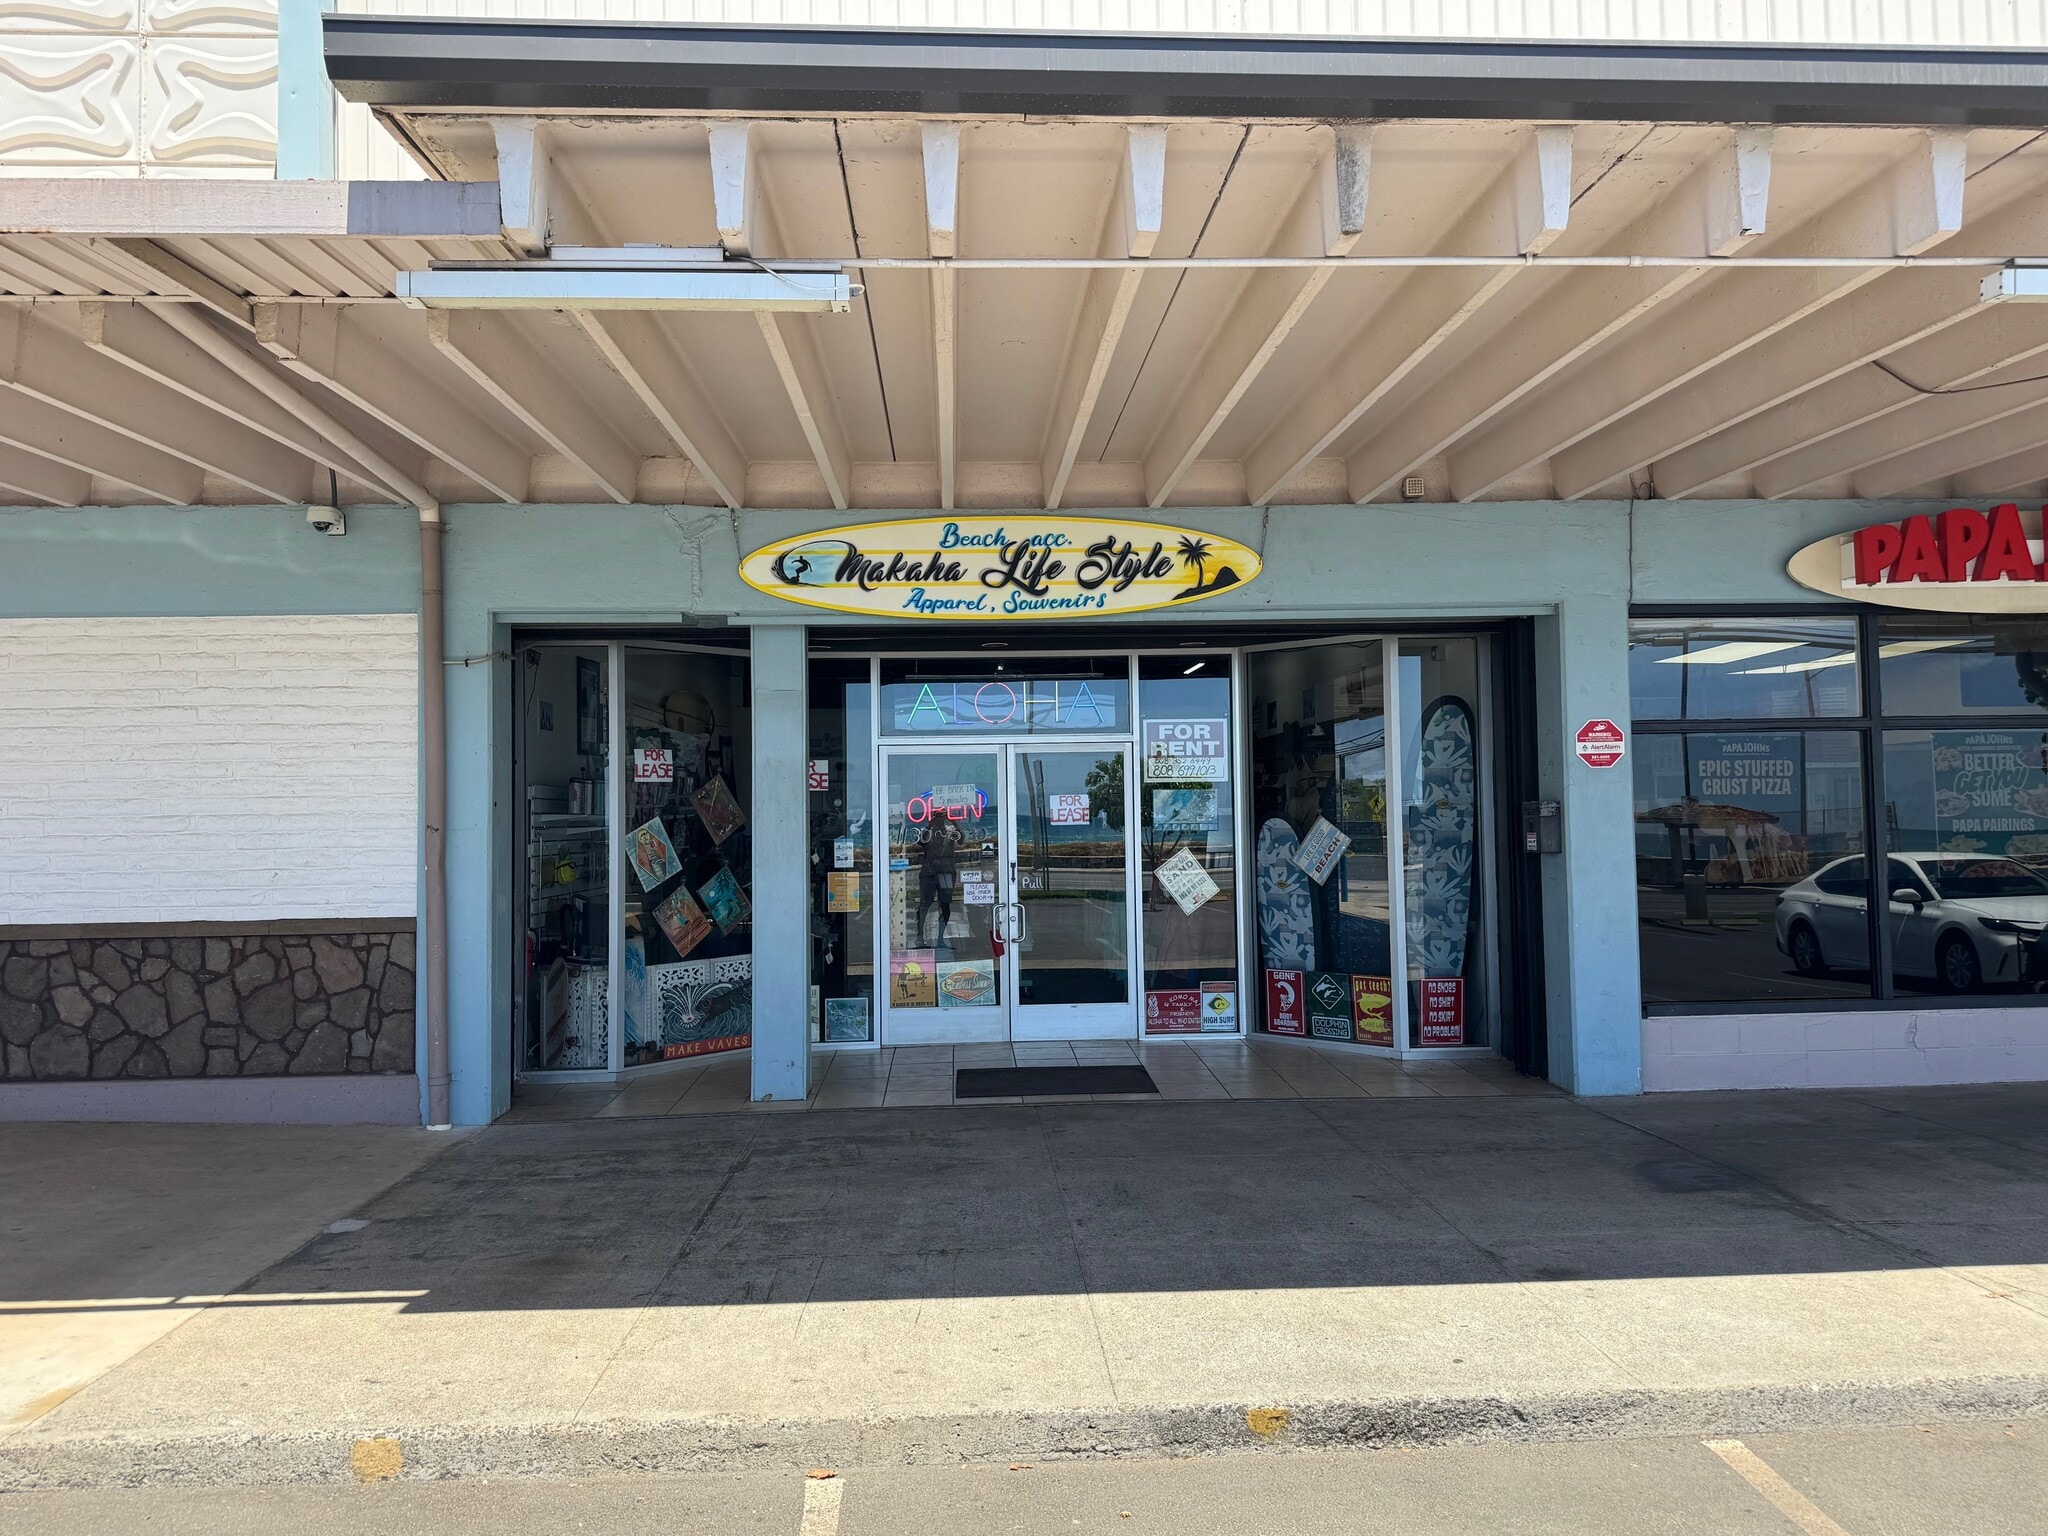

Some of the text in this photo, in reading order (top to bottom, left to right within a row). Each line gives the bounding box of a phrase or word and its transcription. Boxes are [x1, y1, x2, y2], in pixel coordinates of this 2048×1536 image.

[939, 523, 1072, 549] Beach acc.
[1853, 503, 2037, 584] PAPA
[835, 536, 1175, 594] Makaha Life Style
[1003, 590, 1106, 613] Souvenirs
[907, 681, 1104, 725] ALOHA
[1158, 724, 1211, 740] FOR
[1722, 742, 1743, 753] PAPA
[1965, 735, 1986, 745] PAPA
[643, 749, 667, 763] FOR
[1150, 741, 1220, 756] RENT
[1698, 760, 1794, 777] EPIC STUFFED
[1964, 753, 2015, 771] BETTER
[635, 762, 673, 779] LEASE
[1153, 765, 1174, 776] 808
[1702, 778, 1792, 795] CRUST PIZZA
[1955, 766, 2029, 796] GET YOU
[1059, 795, 1084, 807] FOR
[1972, 790, 2012, 807] SOME
[907, 794, 983, 823] OPEN
[1050, 808, 1090, 823] LEASE
[1952, 818, 2035, 832] PAPA PAIRINGS
[1304, 829, 1325, 860] LIFE IS GOOD
[1315, 837, 1341, 873] BEACH
[1166, 860, 1194, 885] SAND
[1022, 876, 1044, 889] Pull
[1273, 971, 1296, 981] GONE
[1355, 980, 1366, 992] got
[1168, 994, 1188, 1002] KOMO
[1438, 997, 1455, 1007] SHIRT
[1203, 1016, 1235, 1024] HIGH SURF
[1314, 1018, 1347, 1029] DOLPHIN
[1438, 1011, 1455, 1022] SKIRT
[1315, 1026, 1348, 1036] CROSSING
[667, 1036, 748, 1057] MAKE WAVES
